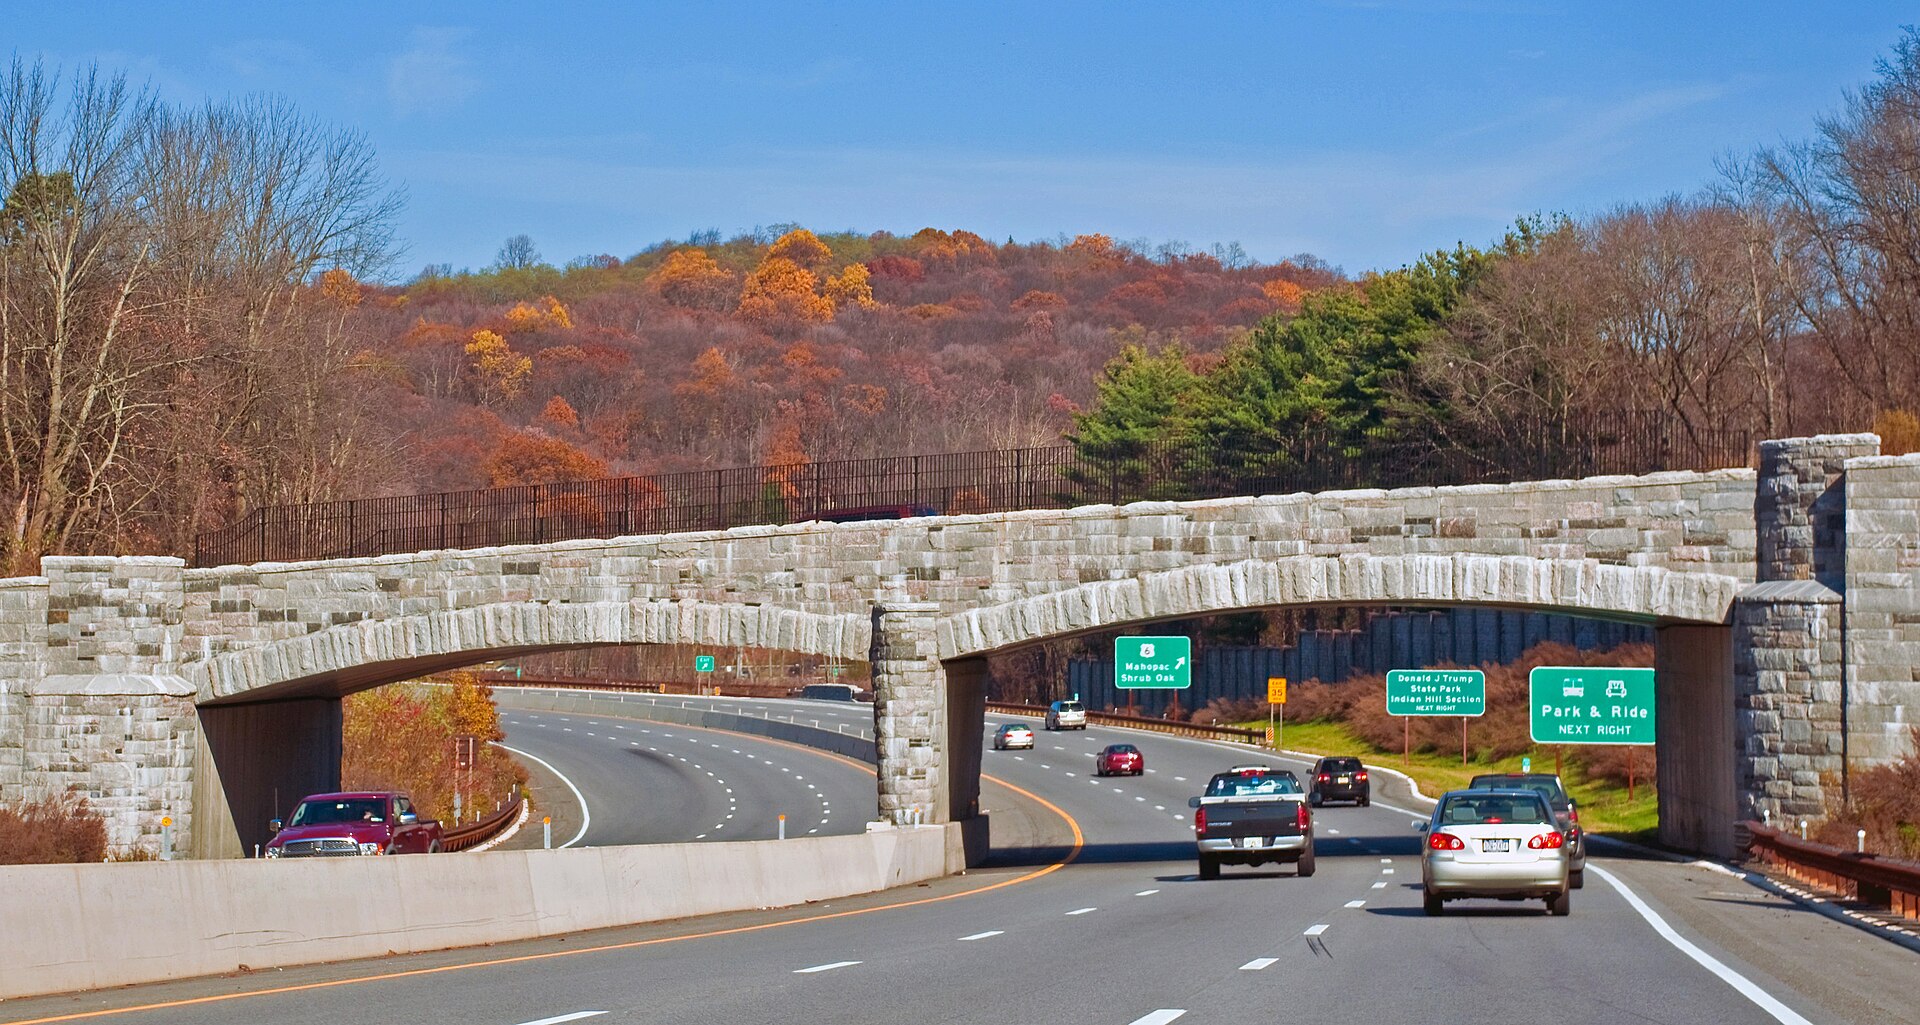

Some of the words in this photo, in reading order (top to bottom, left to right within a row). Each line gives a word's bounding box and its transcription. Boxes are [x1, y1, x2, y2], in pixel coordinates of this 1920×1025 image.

[1144, 646, 1151, 655] 6
[1125, 662, 1170, 671] Mahopac
[1121, 673, 1152, 682] Shrub
[1155, 673, 1175, 682] Oak
[1398, 674, 1431, 682] Donald
[1434, 674, 1440, 682] J
[1443, 674, 1473, 684] Trump
[1271, 688, 1283, 696] 35
[1410, 685, 1437, 693] State
[1440, 685, 1461, 693] Park
[1390, 695, 1422, 703] Indian
[1425, 695, 1442, 703] Hill
[1445, 695, 1481, 703] Section
[1541, 704, 1581, 718] Park
[1589, 705, 1602, 718] &
[1611, 705, 1648, 718] Ride
[1559, 724, 1590, 735] NEXT
[1597, 725, 1632, 735] RIGHT
